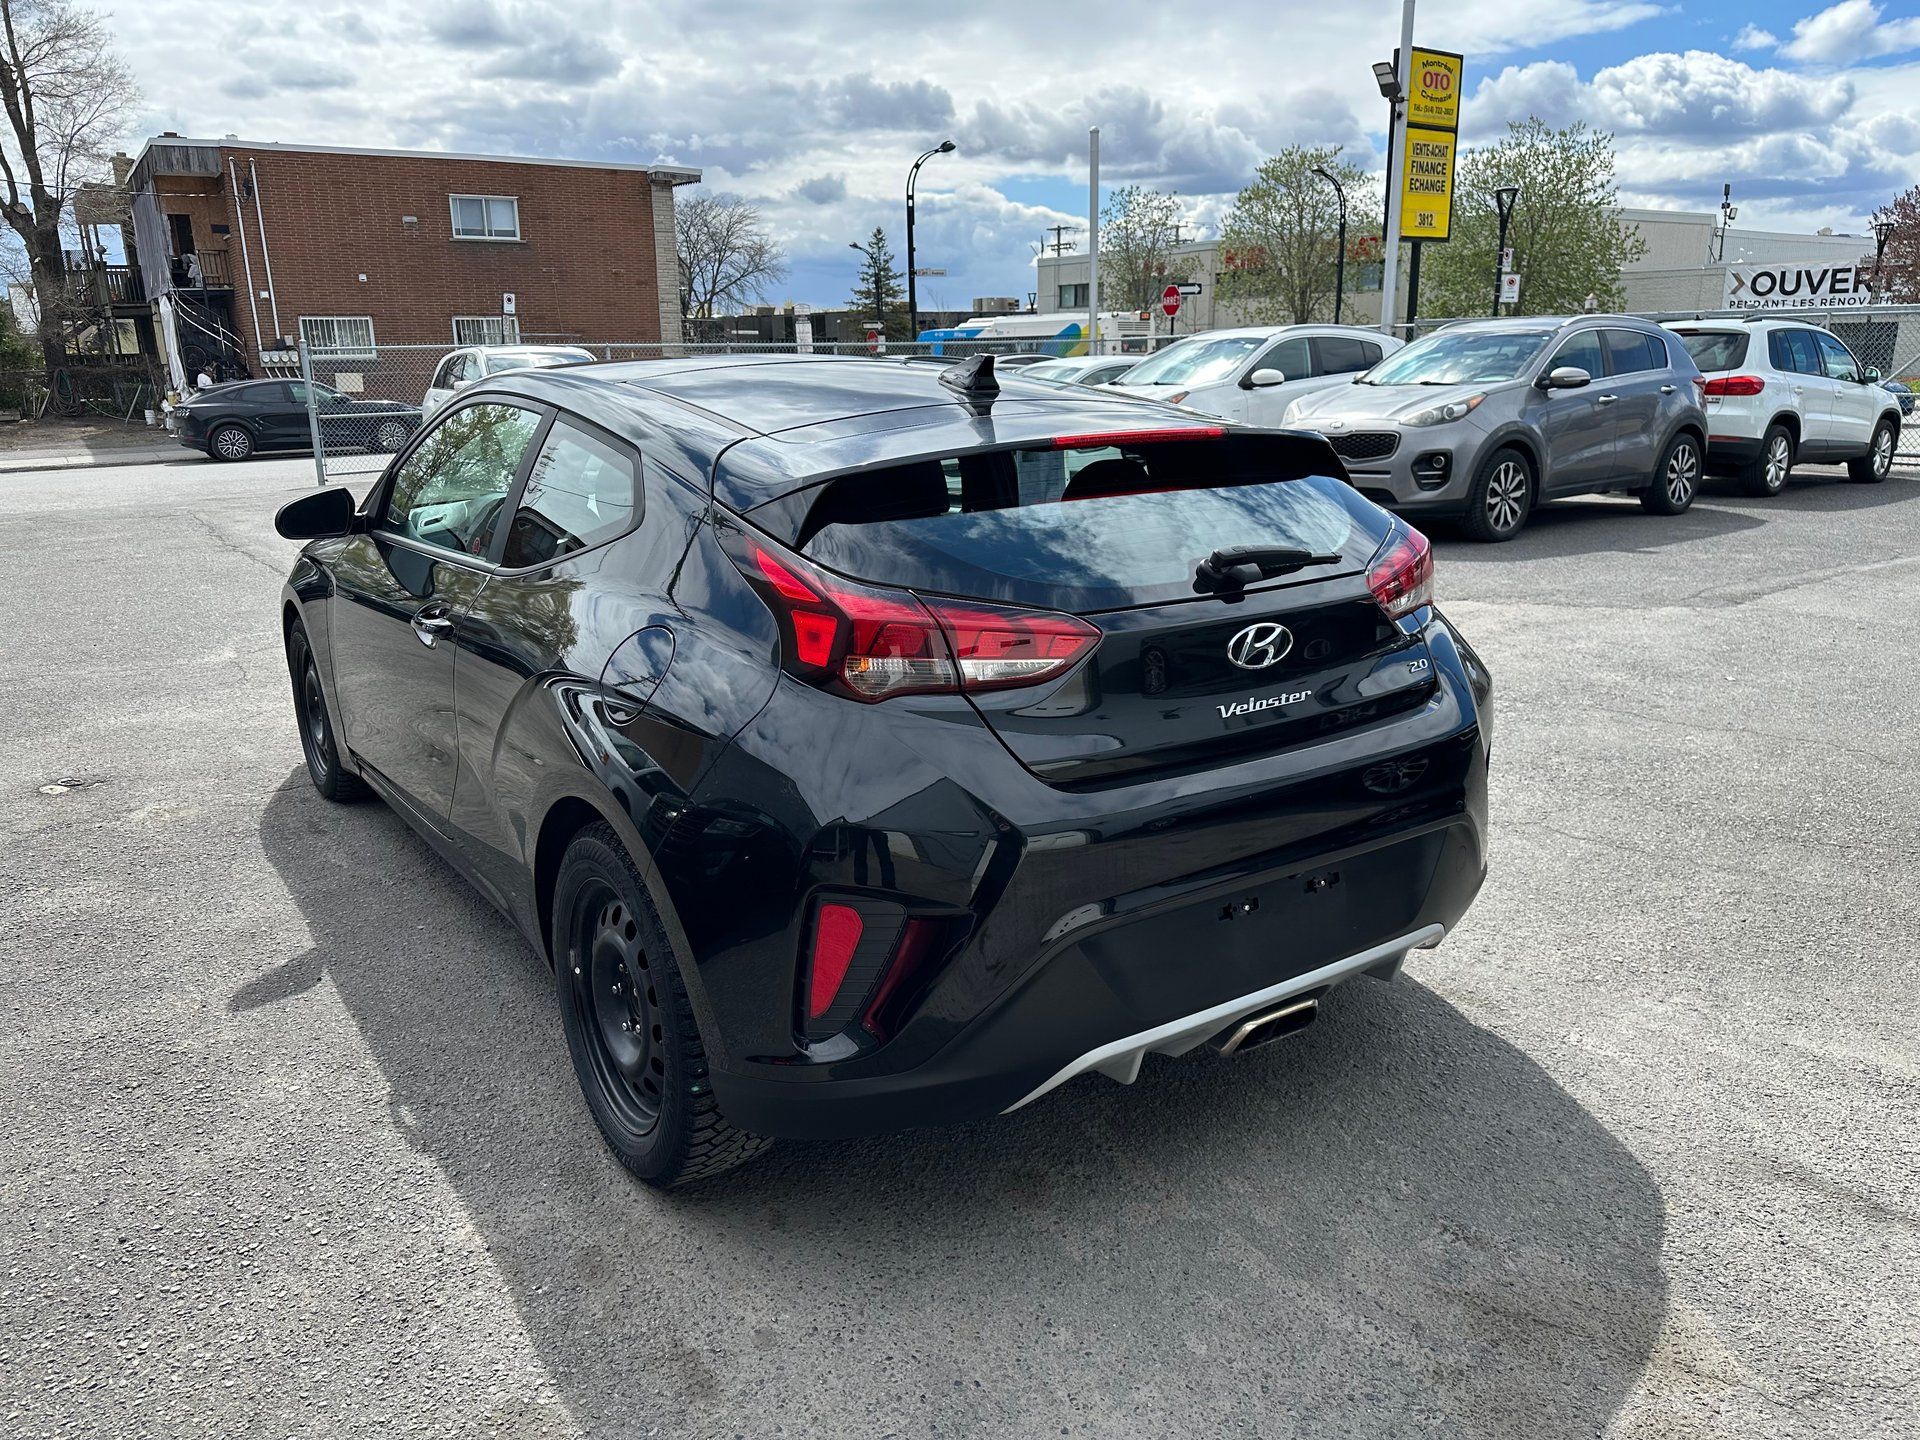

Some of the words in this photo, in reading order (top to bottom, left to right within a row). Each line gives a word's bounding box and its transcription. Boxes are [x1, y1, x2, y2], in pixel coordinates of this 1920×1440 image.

[1422, 60, 1453, 74] Montréal
[1423, 71, 1450, 90] OTO
[1421, 90, 1452, 102] Crémazie
[1412, 143, 1448, 157] VENTE-ACHAT
[1411, 160, 1447, 175] FINANCE
[1410, 178, 1446, 192] ECHANGE
[1419, 213, 1433, 226] 3812
[1750, 265, 1874, 297] OUVER
[1792, 298, 1815, 307] LES
[1216, 690, 1312, 718] Veloster
